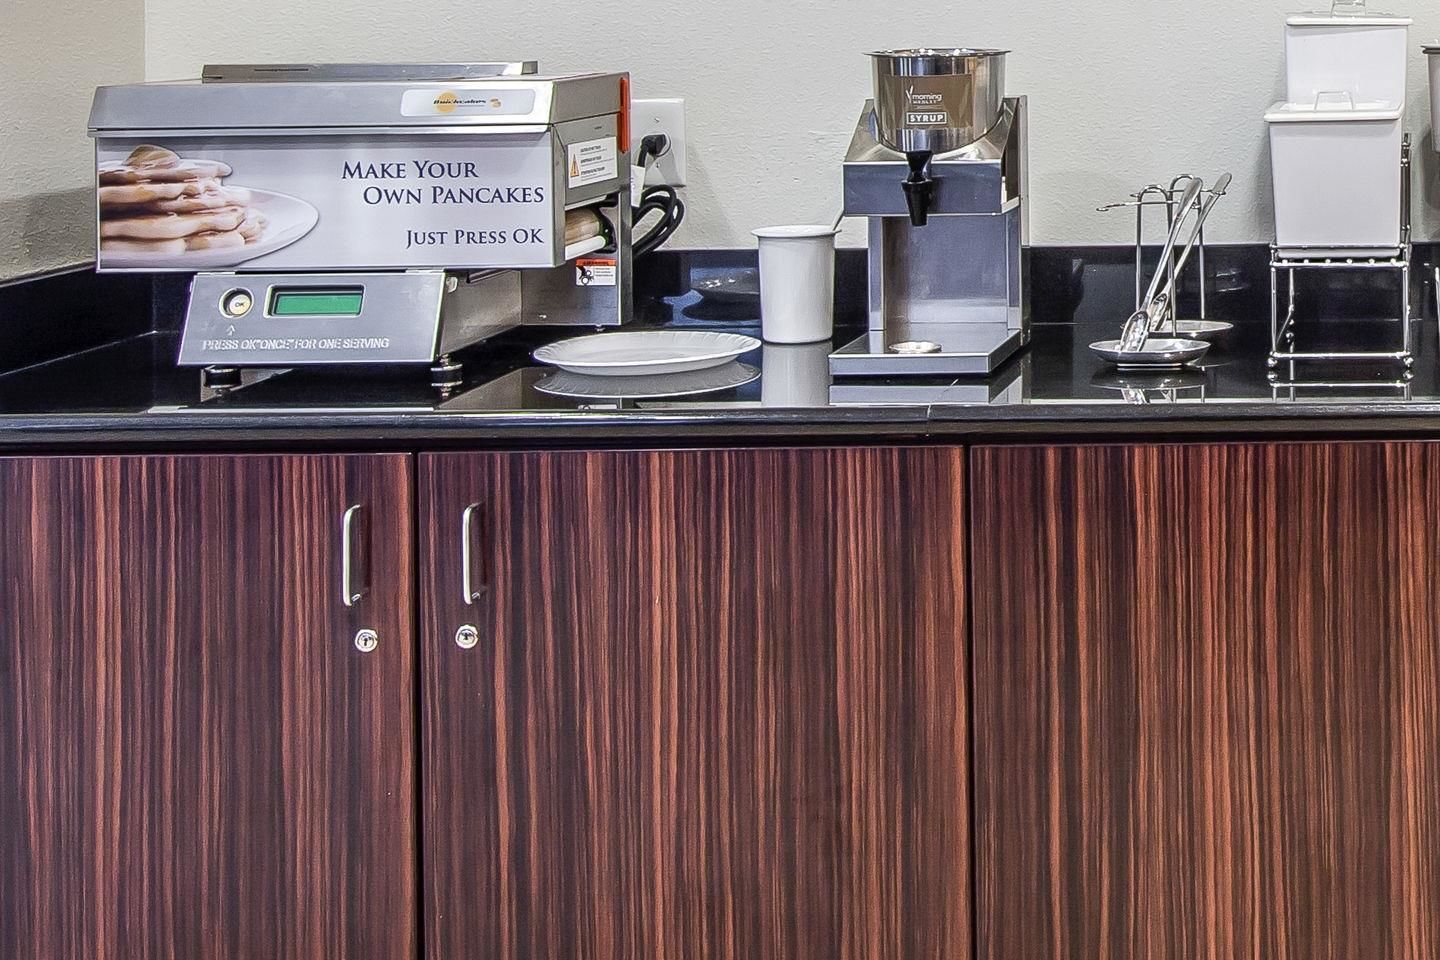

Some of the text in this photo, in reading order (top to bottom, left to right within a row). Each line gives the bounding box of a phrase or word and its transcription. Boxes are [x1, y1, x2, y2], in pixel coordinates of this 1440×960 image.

[912, 92, 942, 102] morning
[910, 114, 944, 122] SYRUP
[341, 160, 479, 179] MAKE YOUR
[363, 186, 545, 204] OWN PANCAKES
[406, 228, 545, 249] JUST PRESS OK
[202, 340, 239, 351] PRESS
[295, 339, 316, 350] FOR
[318, 339, 342, 349] ONE
[343, 338, 390, 349] SERVING
